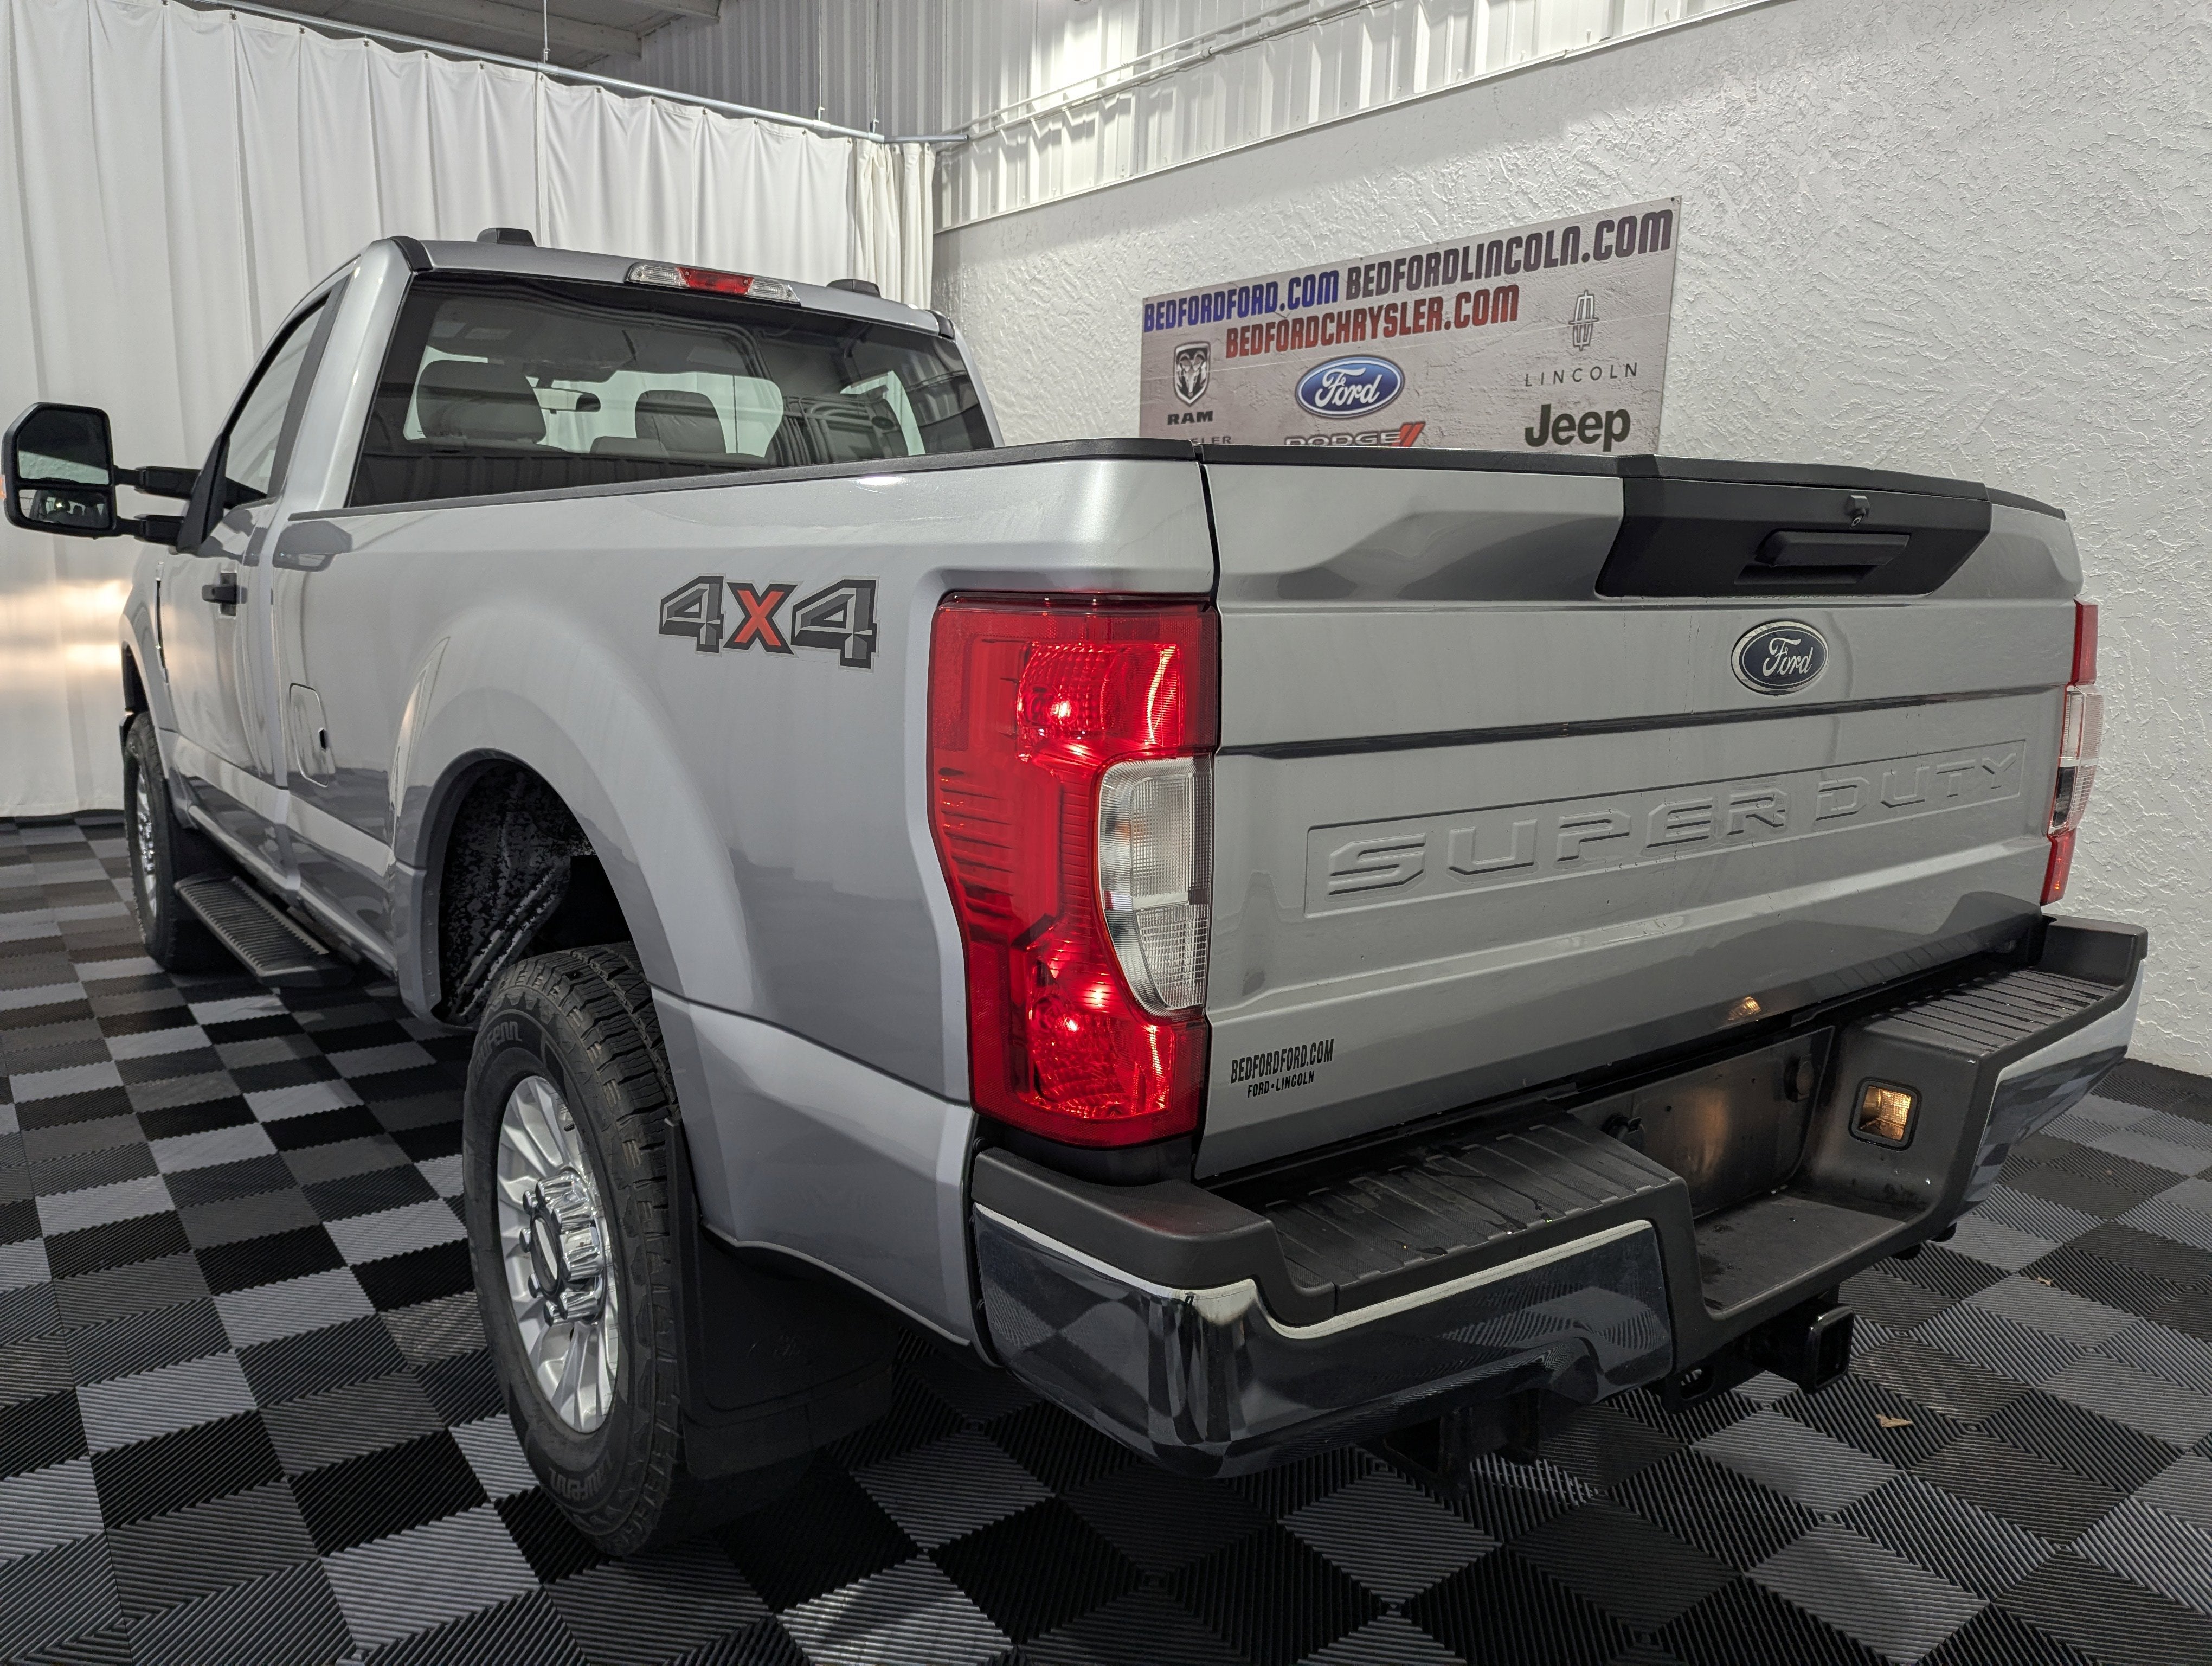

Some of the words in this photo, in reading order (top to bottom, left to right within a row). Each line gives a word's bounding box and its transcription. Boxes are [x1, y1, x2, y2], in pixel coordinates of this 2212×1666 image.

[1144, 270, 1339, 332] BEDFORDFORD.COM
[1346, 209, 1673, 300] BEDFORDLINCOLN.COM
[1226, 284, 1519, 358] BEDFORDCHRYSLER.COM
[1315, 367, 1383, 407] Ford
[1525, 362, 1638, 387] LINCOLN
[1167, 411, 1213, 425] RAM
[1284, 429, 1401, 447] DODGE
[1524, 403, 1631, 453] Jeep
[658, 573, 879, 672] 4X4
[1763, 637, 1814, 676] Ford
[1326, 787, 1789, 898] SUPER
[1815, 752, 2017, 822] DUTY
[1230, 1038, 1334, 1084] BEDFORDFORD.COM
